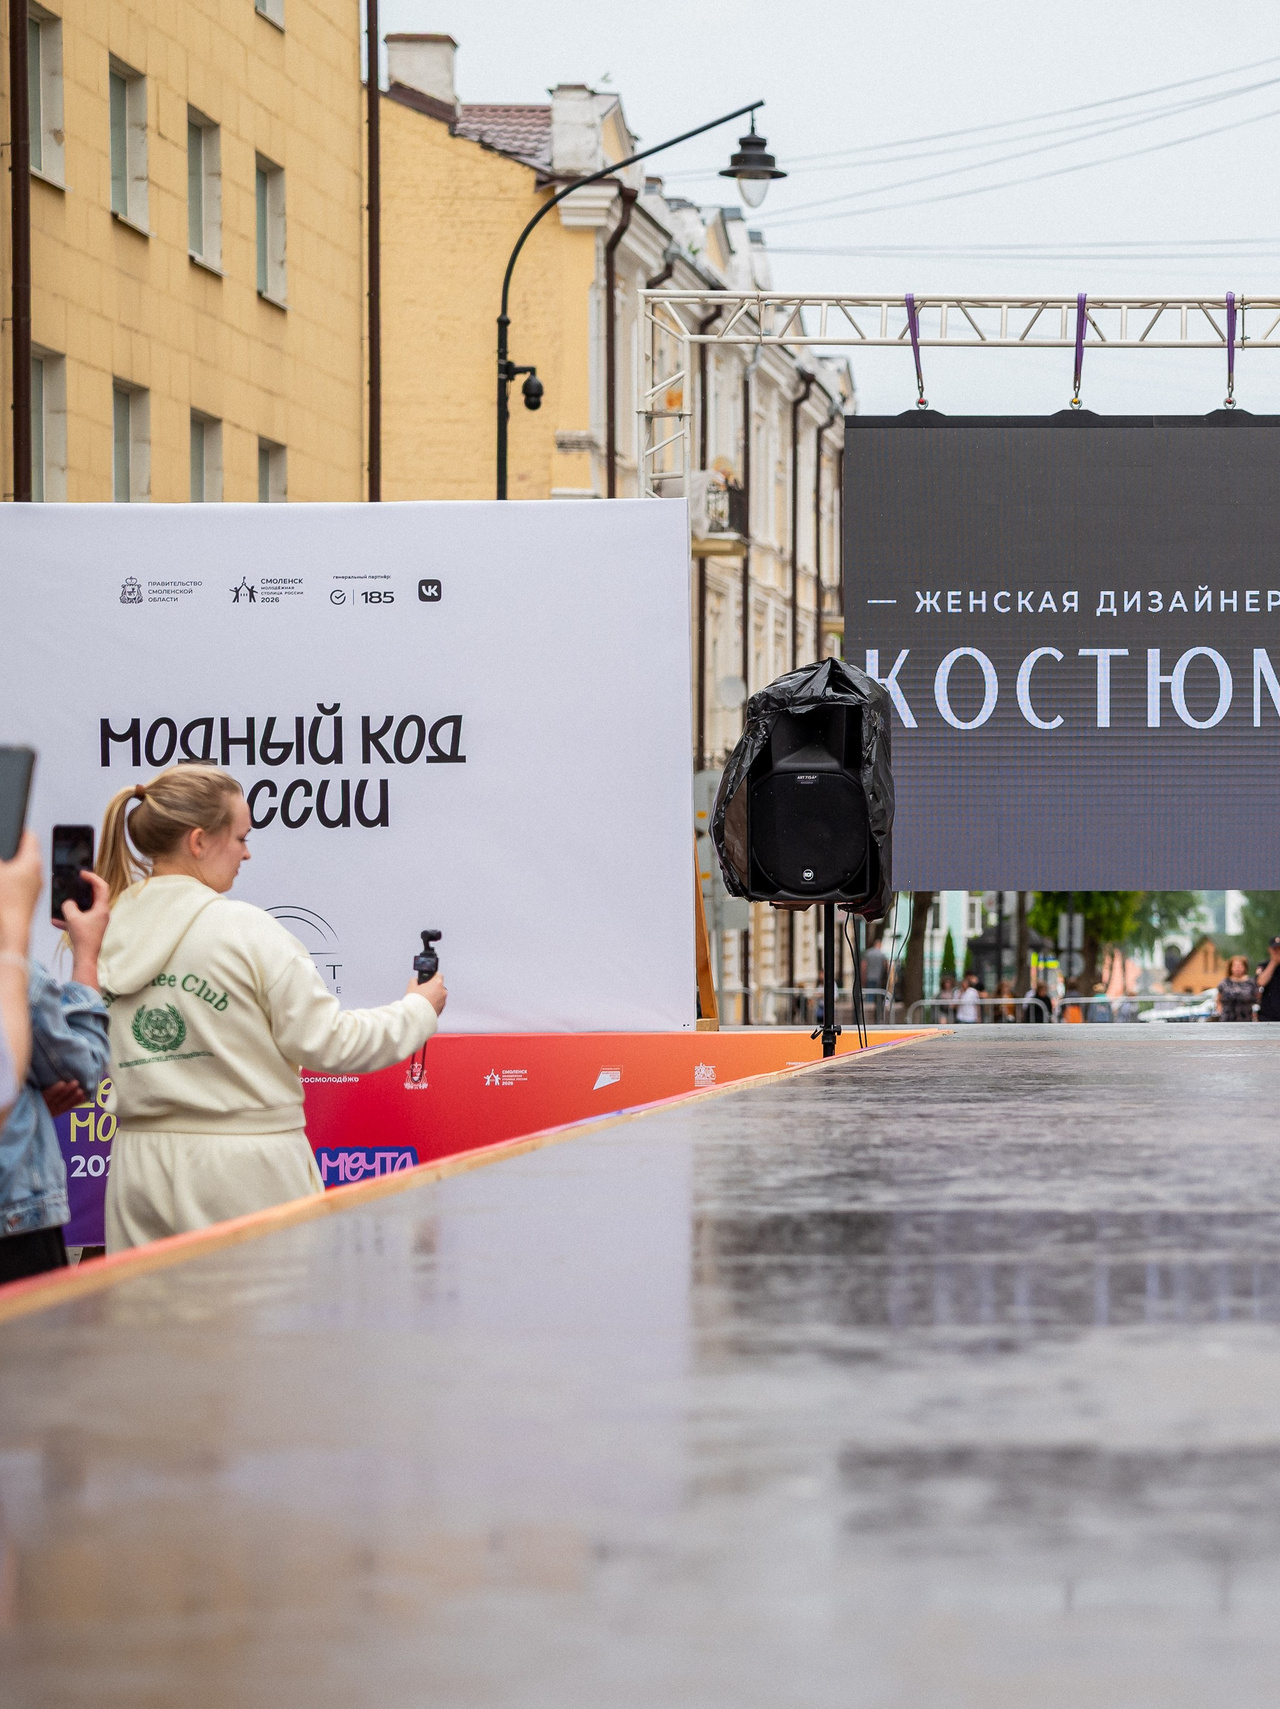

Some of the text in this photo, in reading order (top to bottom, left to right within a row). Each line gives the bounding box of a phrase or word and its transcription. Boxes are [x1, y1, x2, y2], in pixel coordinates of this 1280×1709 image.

[361, 591, 395, 604] 185
[421, 585, 439, 597] VK
[914, 590, 1080, 613] ЖЕНСКАЯ
[100, 702, 467, 767] МОДНЫЙ КОД
[249, 778, 389, 829] ССИИ
[181, 973, 230, 1012] Club
